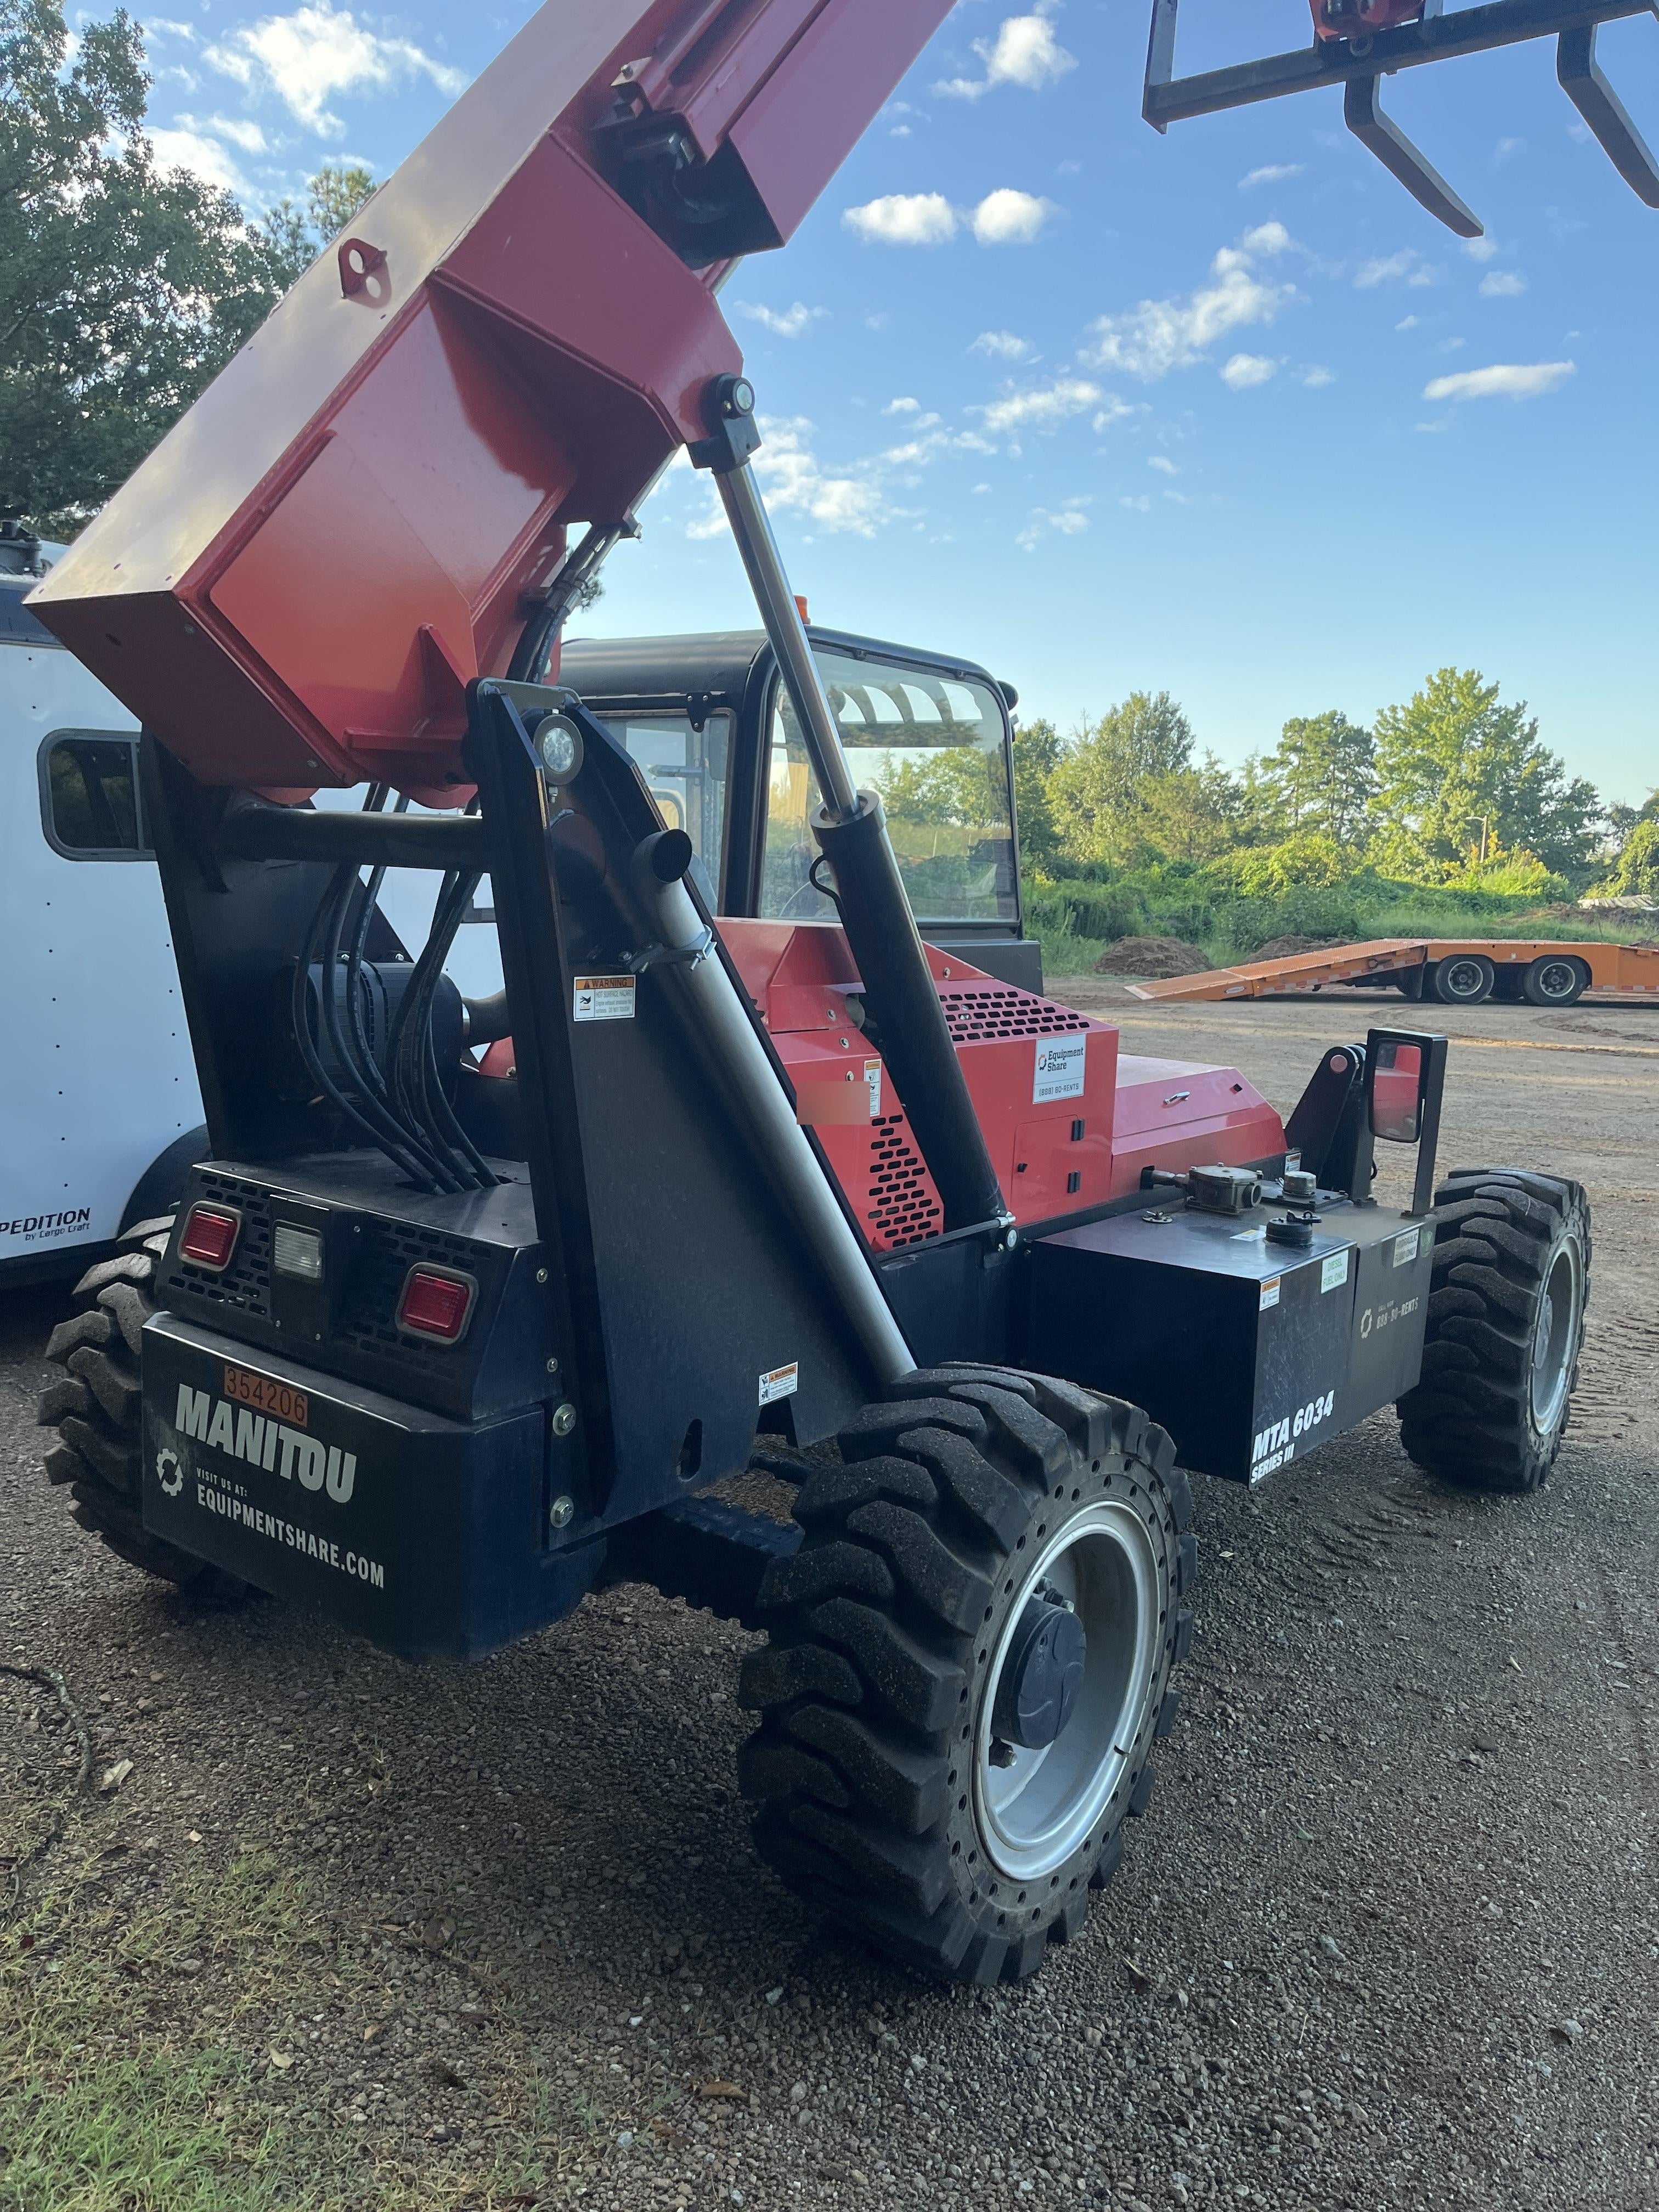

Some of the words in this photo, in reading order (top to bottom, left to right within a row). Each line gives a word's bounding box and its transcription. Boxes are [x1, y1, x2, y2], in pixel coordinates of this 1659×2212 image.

[592, 979, 628, 988] WARNING
[1048, 1047, 1084, 1062] Equipment
[1047, 1062, 1067, 1071] Share
[1039, 1087, 1054, 1097] (888)
[1054, 1083, 1079, 1093] 80-RENTS
[40, 1228, 65, 1239] Cargo
[68, 1223, 91, 1233] Craft
[1328, 1257, 1342, 1271] DIESEL
[1323, 1276, 1334, 1288] FUEL
[1334, 1270, 1346, 1282] ONLY
[227, 1368, 306, 1423] 354206
[1252, 1417, 1289, 1463] MTA
[1293, 1390, 1335, 1437] 6034
[175, 1383, 357, 1503] MANITOU
[1251, 1450, 1283, 1483] SERIES
[1283, 1443, 1295, 1463] III
[196, 1467, 218, 1483] VISIT
[221, 1477, 231, 1491] US
[235, 1486, 247, 1497] AT:
[197, 1483, 384, 1589] EQUIPMENTSHARE.COM
